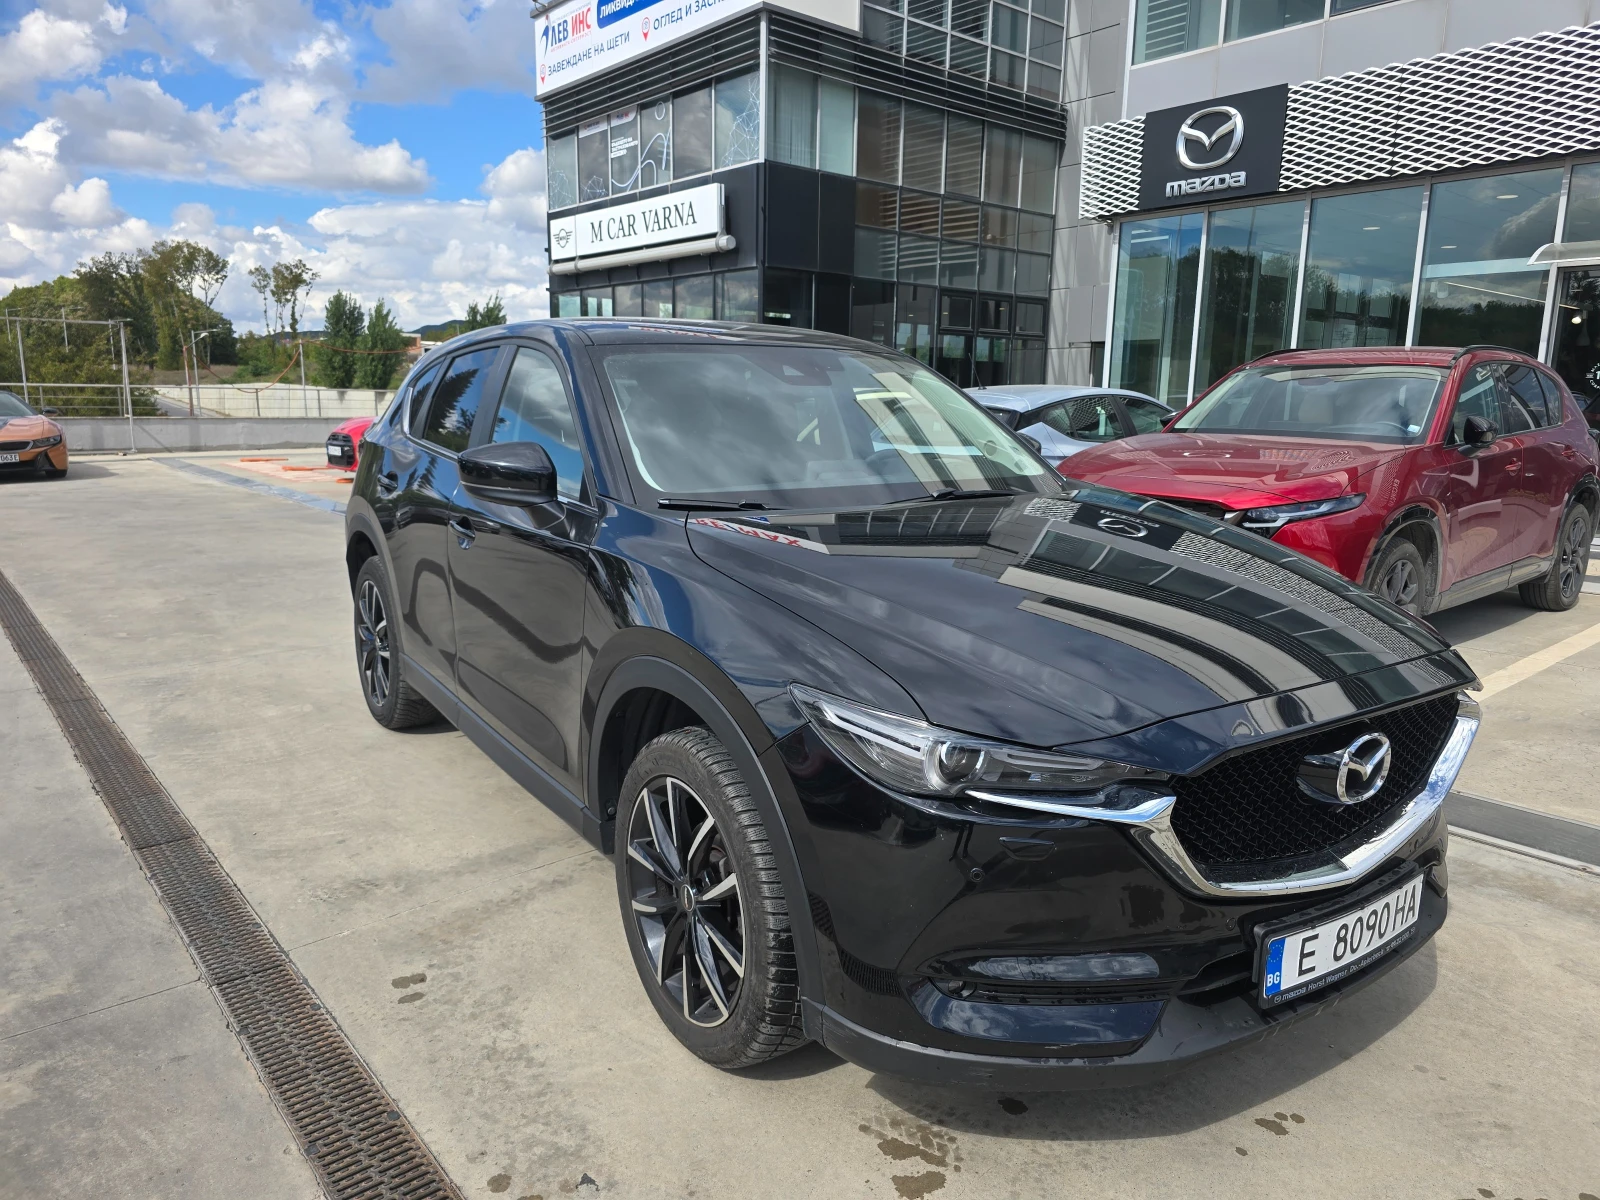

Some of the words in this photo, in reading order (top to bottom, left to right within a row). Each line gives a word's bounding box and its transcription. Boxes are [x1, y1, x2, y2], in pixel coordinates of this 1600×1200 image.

[551, 19, 569, 47] ЛЕВ
[571, 7, 592, 37] ИНС
[653, 11, 683, 30] ОГЛЕД
[685, 3, 692, 17] И
[548, 47, 592, 76] ЗАВЕЖДАНЕ
[593, 42, 605, 56] НА
[606, 31, 630, 51] ЩЕТИ
[590, 220, 603, 243] M
[607, 213, 638, 240] CAR
[641, 201, 697, 234] VARNA
[1297, 932, 1319, 978] E
[1266, 971, 1281, 987] BG
